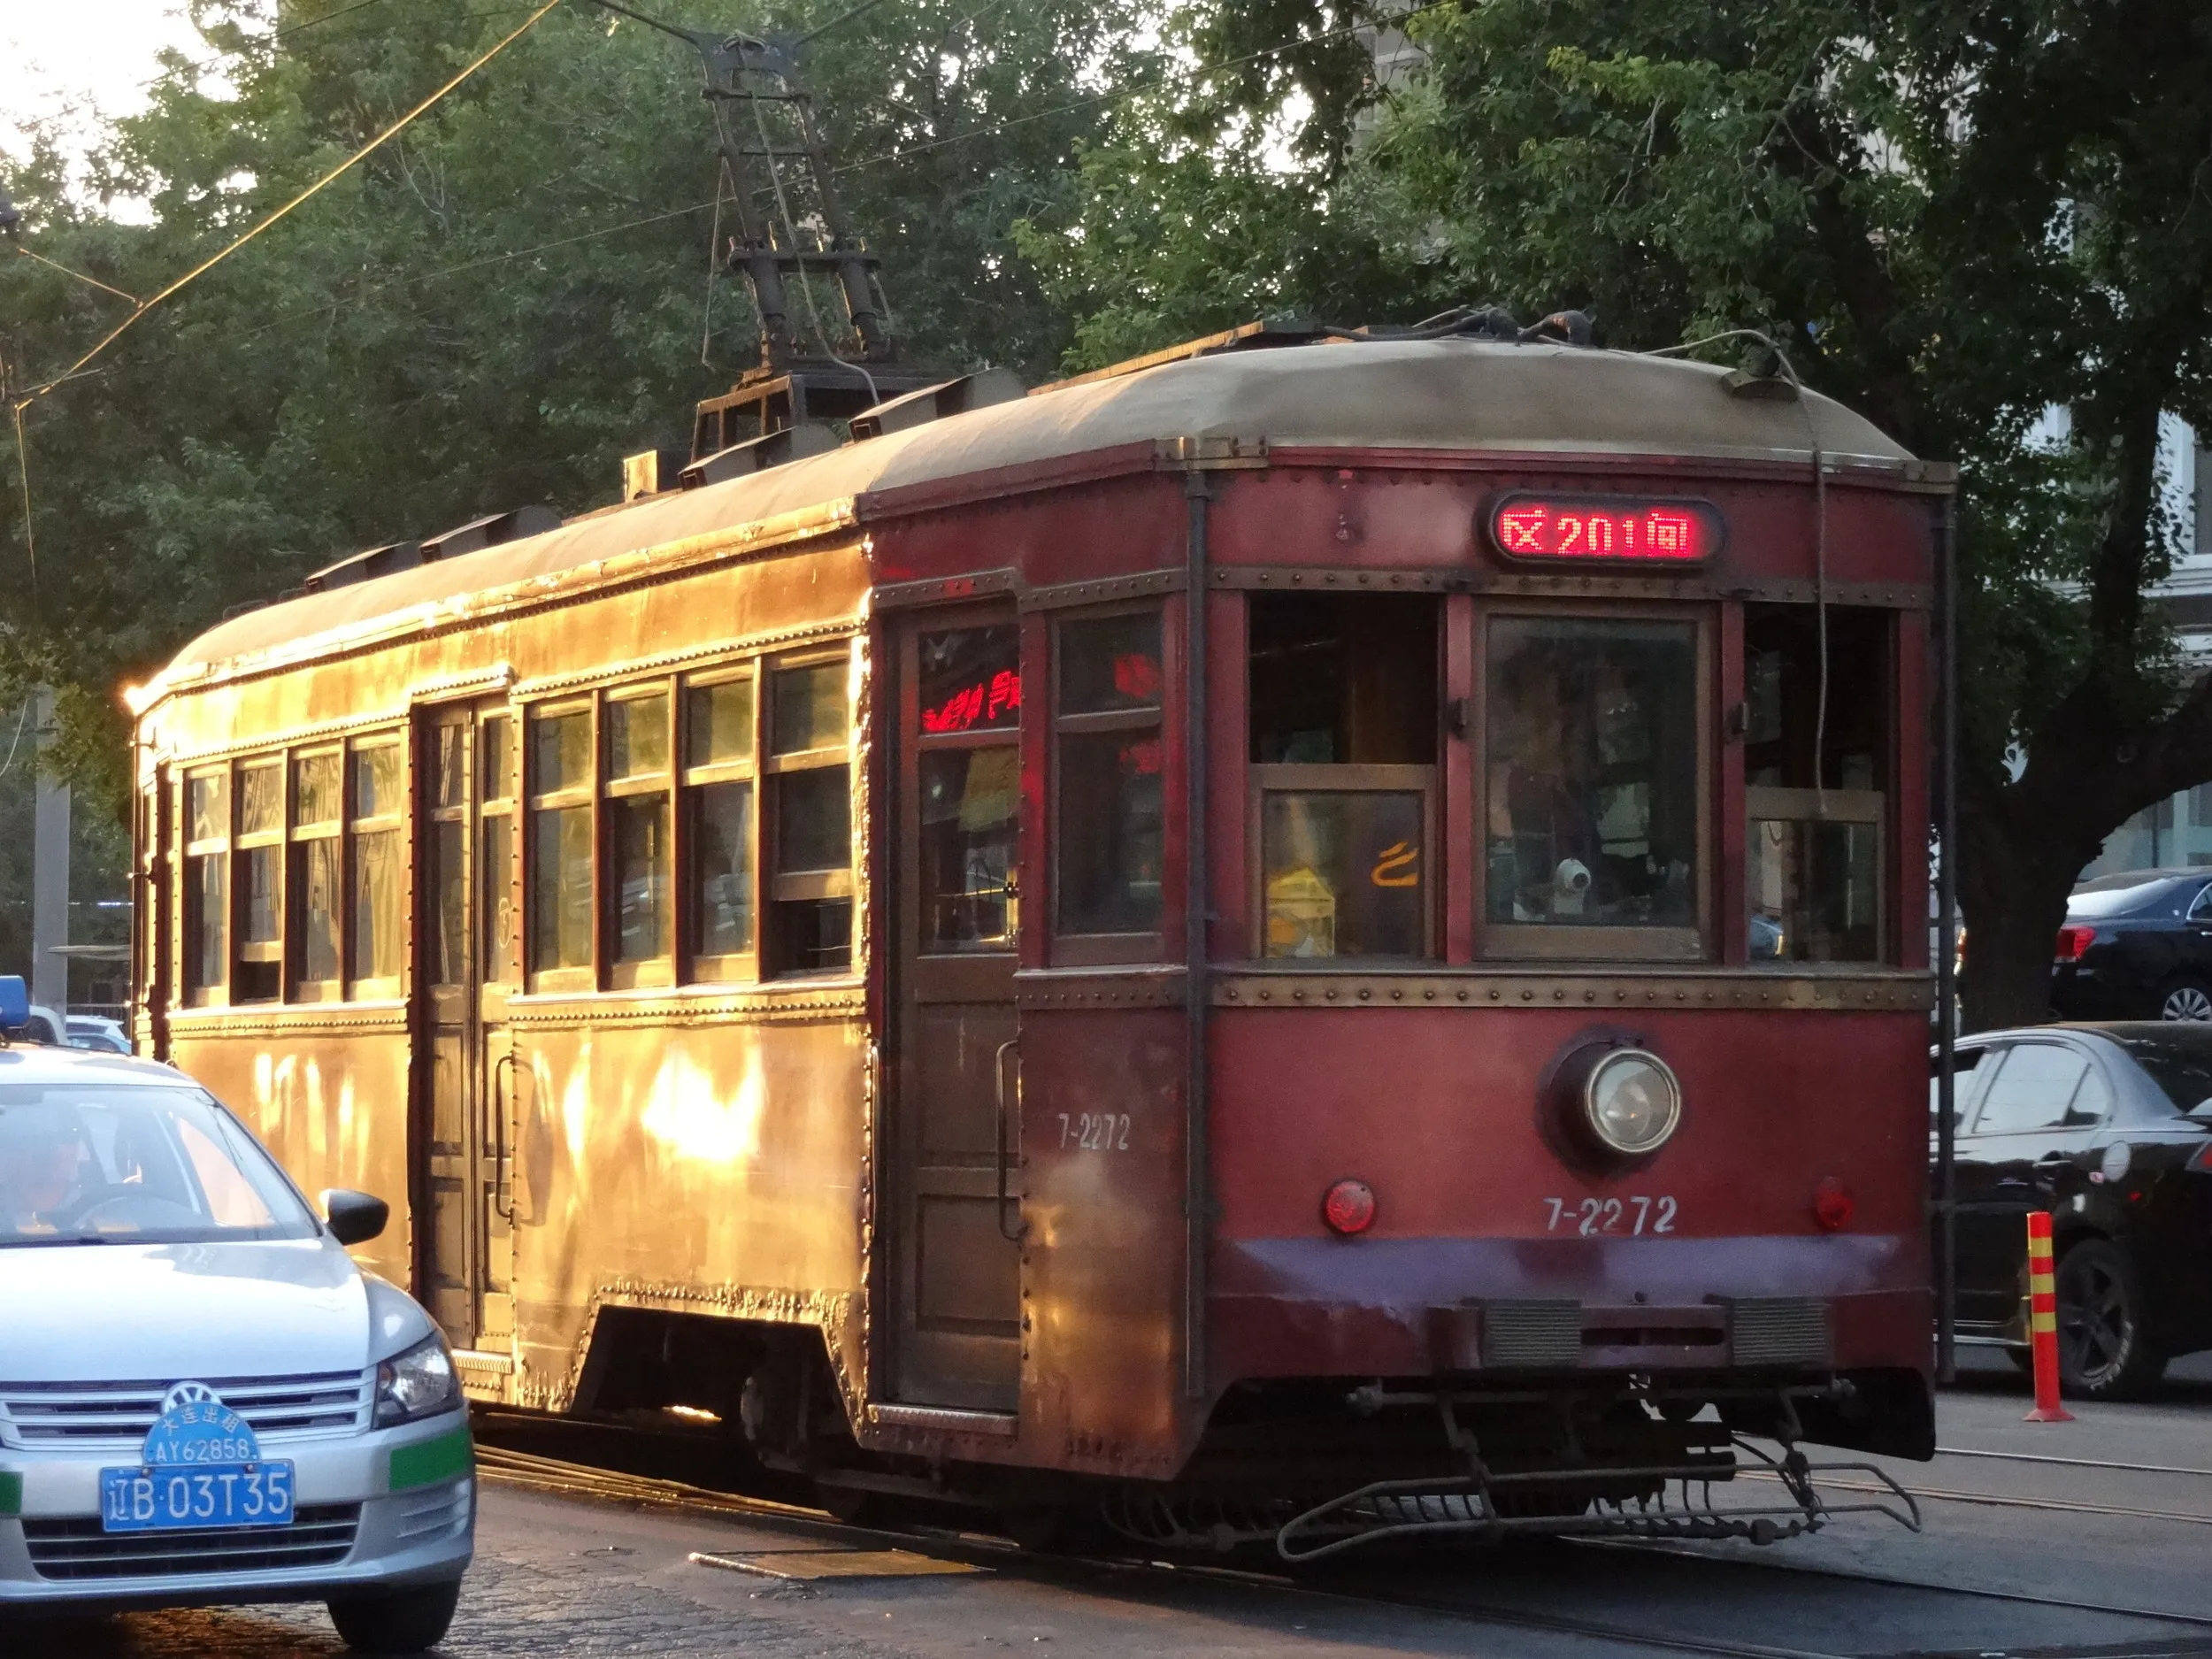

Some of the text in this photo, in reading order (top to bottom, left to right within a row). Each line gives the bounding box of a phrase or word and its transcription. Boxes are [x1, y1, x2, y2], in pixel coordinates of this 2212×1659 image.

[1058, 1113, 1131, 1150] 7-2272
[1543, 1195, 1678, 1236] 7-2272
[162, 1406, 240, 1435] 大连出租
[156, 1438, 249, 1464] AY62858
